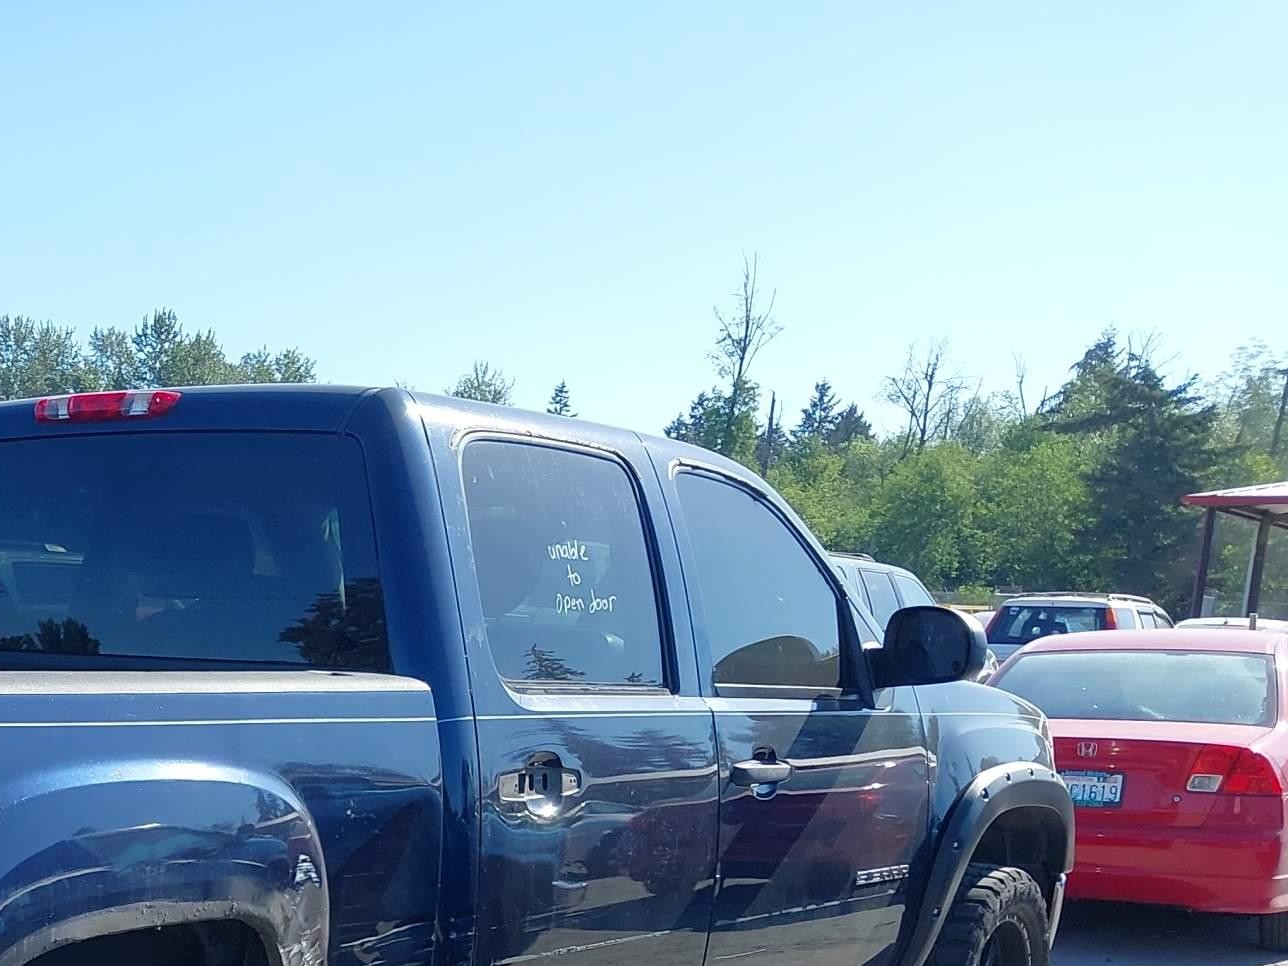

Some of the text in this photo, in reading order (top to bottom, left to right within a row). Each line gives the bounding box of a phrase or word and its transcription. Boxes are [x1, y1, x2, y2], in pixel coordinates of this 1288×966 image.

[548, 540, 589, 560] unable
[567, 564, 581, 586] to
[589, 588, 617, 614] door
[1067, 783, 1118, 802] C1619
